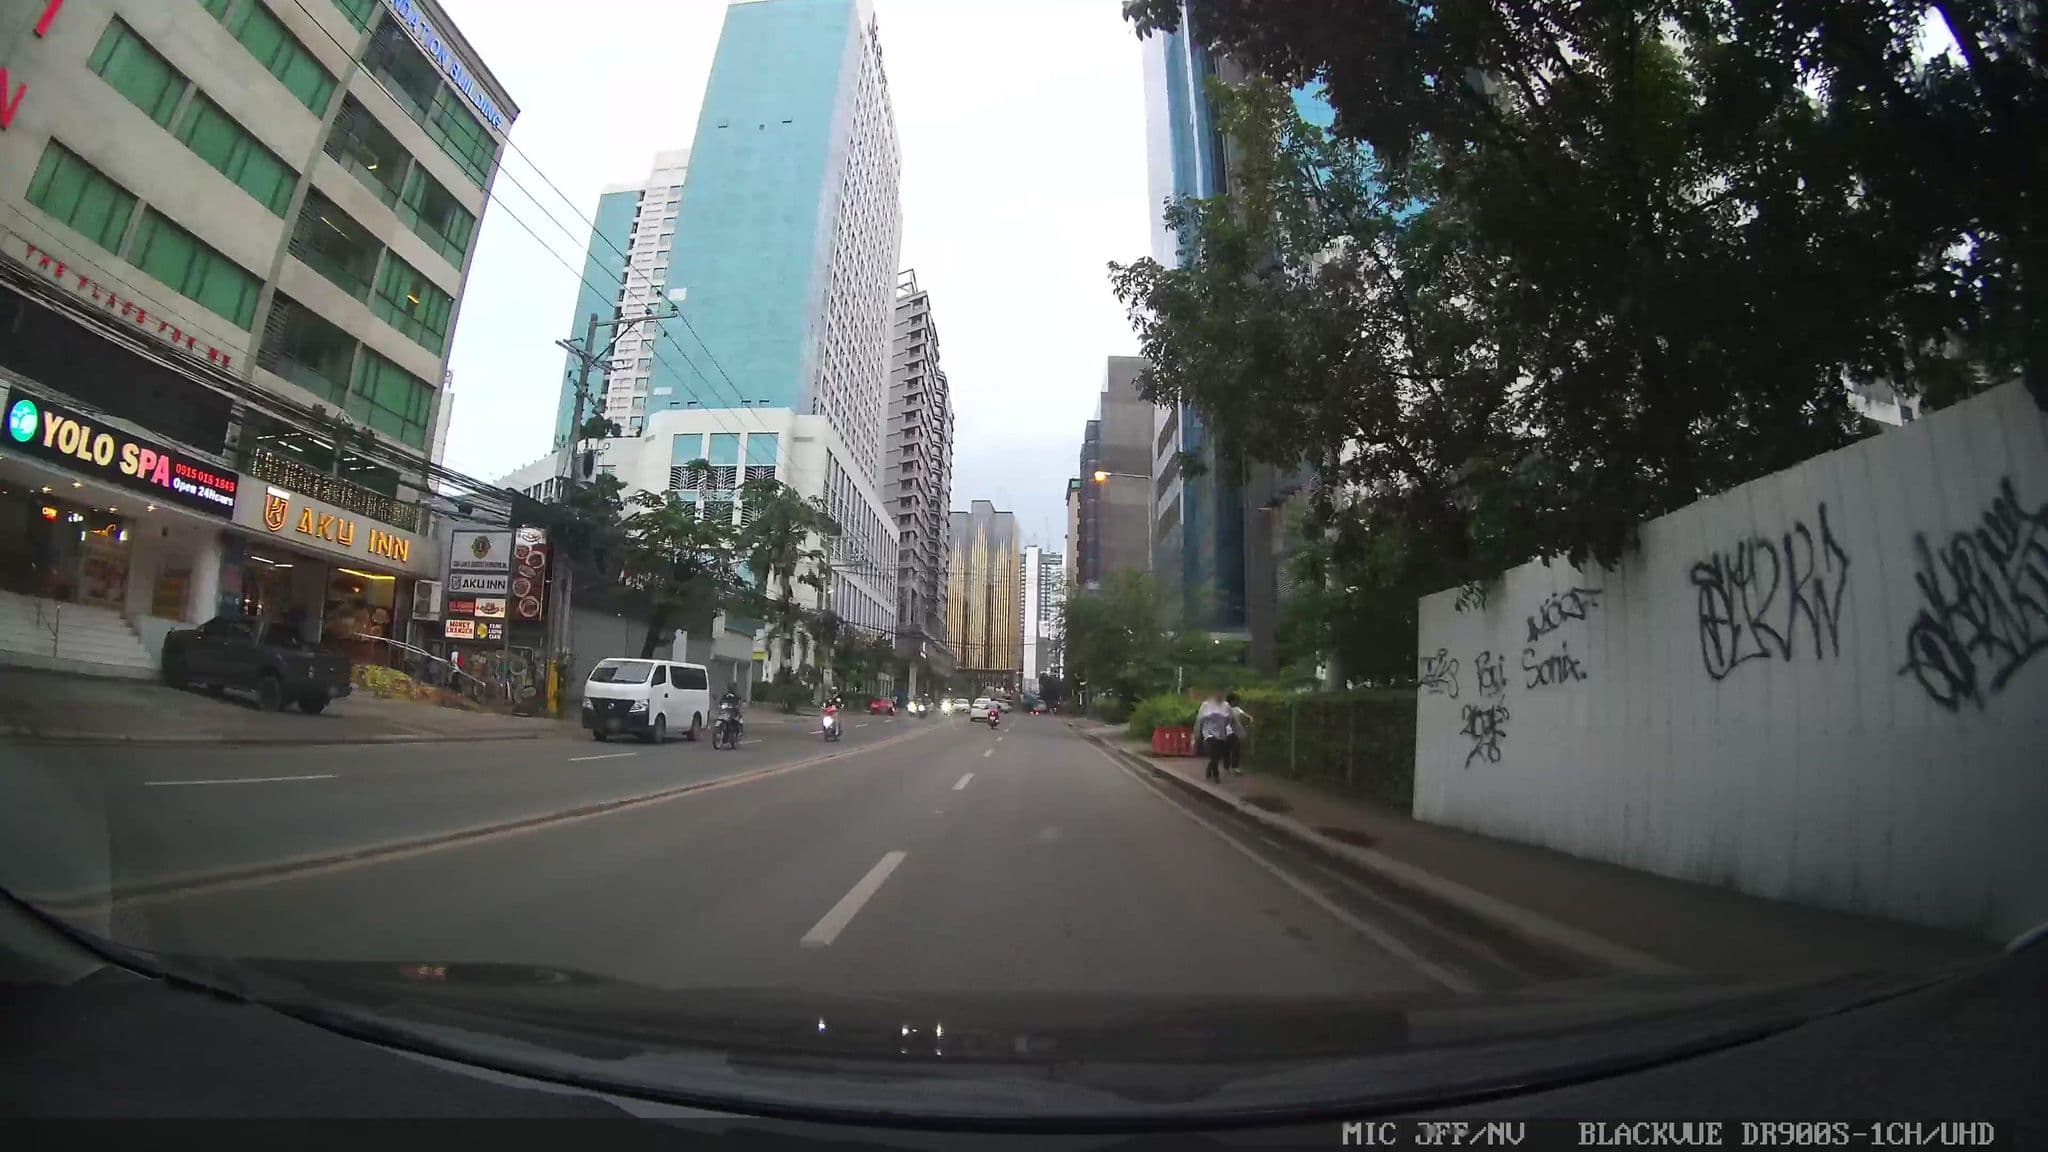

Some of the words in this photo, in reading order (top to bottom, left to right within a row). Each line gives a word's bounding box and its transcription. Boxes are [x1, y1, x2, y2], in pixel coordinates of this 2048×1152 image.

[450, 60, 502, 128] BUILDING
[42, 411, 115, 466] YOLO
[119, 443, 170, 488] SPA
[172, 477, 198, 495] Open
[197, 486, 234, 507] 24Hours
[175, 463, 198, 480] 0915
[296, 507, 355, 546] AKU
[368, 527, 411, 563] INN
[462, 579, 485, 589] AKU
[486, 579, 506, 590] INN
